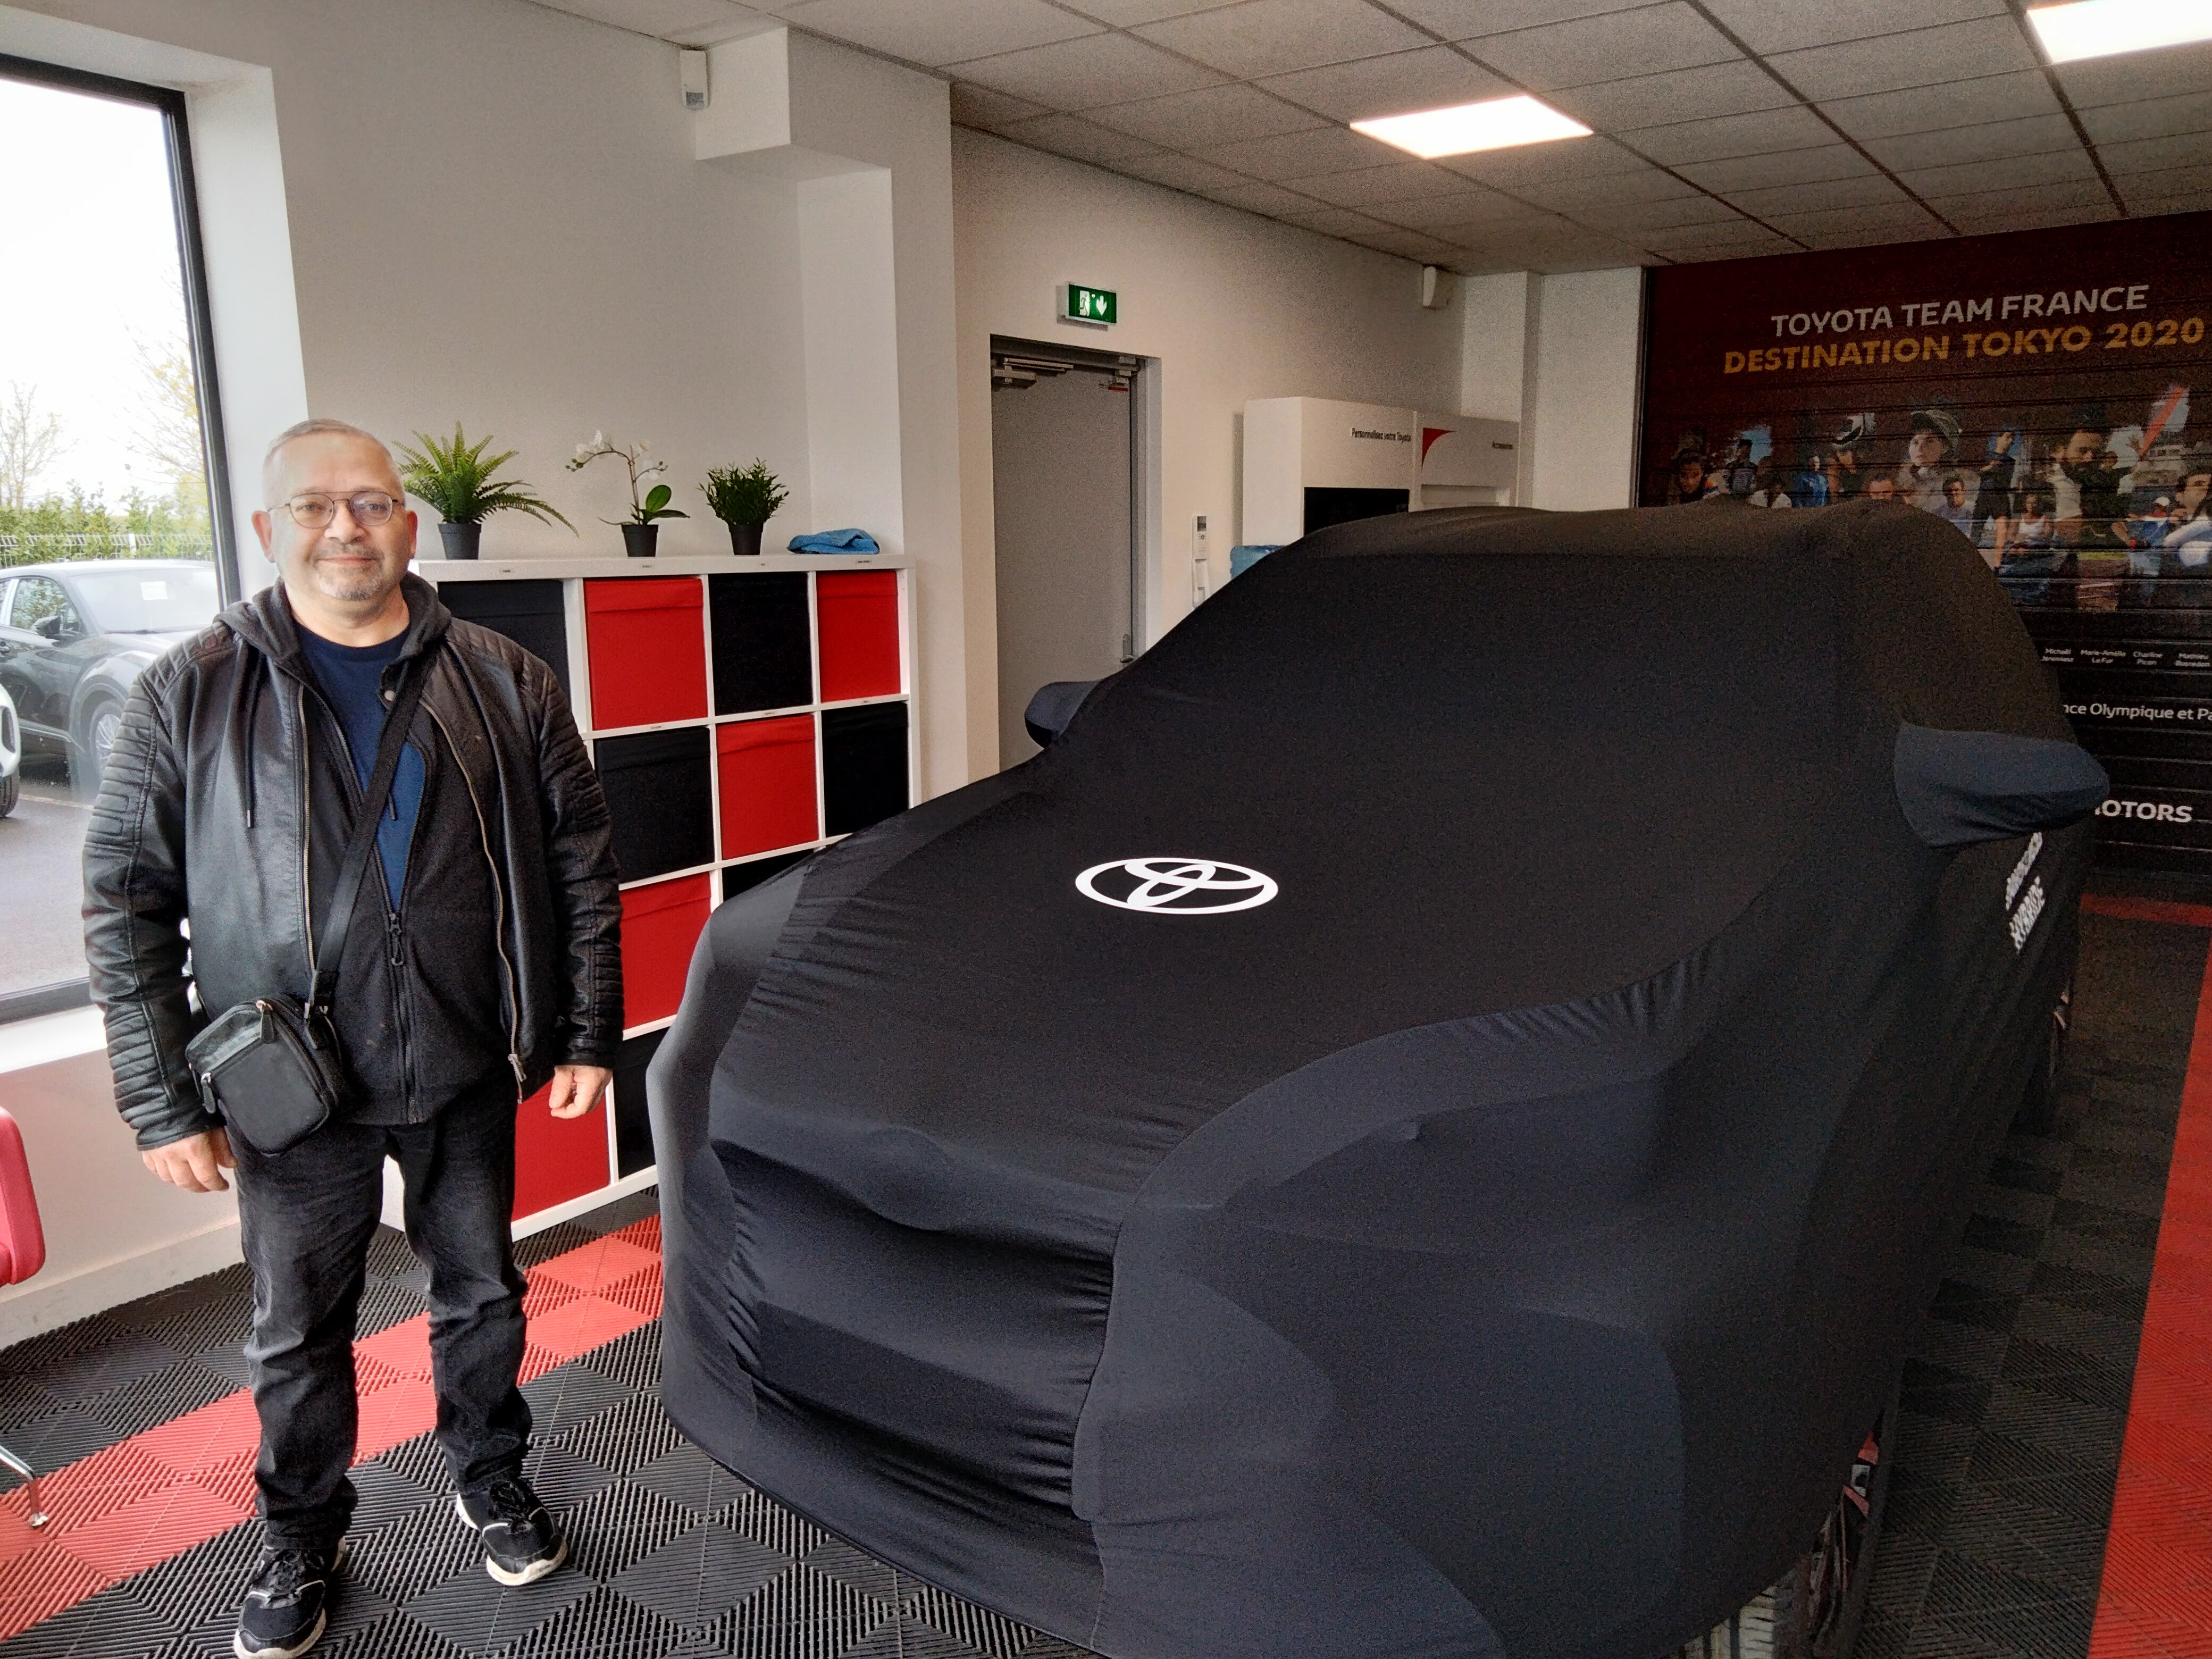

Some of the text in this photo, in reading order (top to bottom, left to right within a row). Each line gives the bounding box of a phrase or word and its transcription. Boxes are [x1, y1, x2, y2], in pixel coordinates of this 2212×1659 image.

[1771, 284, 2149, 337] TOYOTA TEAM FRANCE
[1723, 317, 2205, 374] DESTINATION TOKYO 2020
[2090, 703, 2174, 720] Olympique
[2177, 708, 2194, 720] et
[2094, 800, 2192, 823] OTORS
